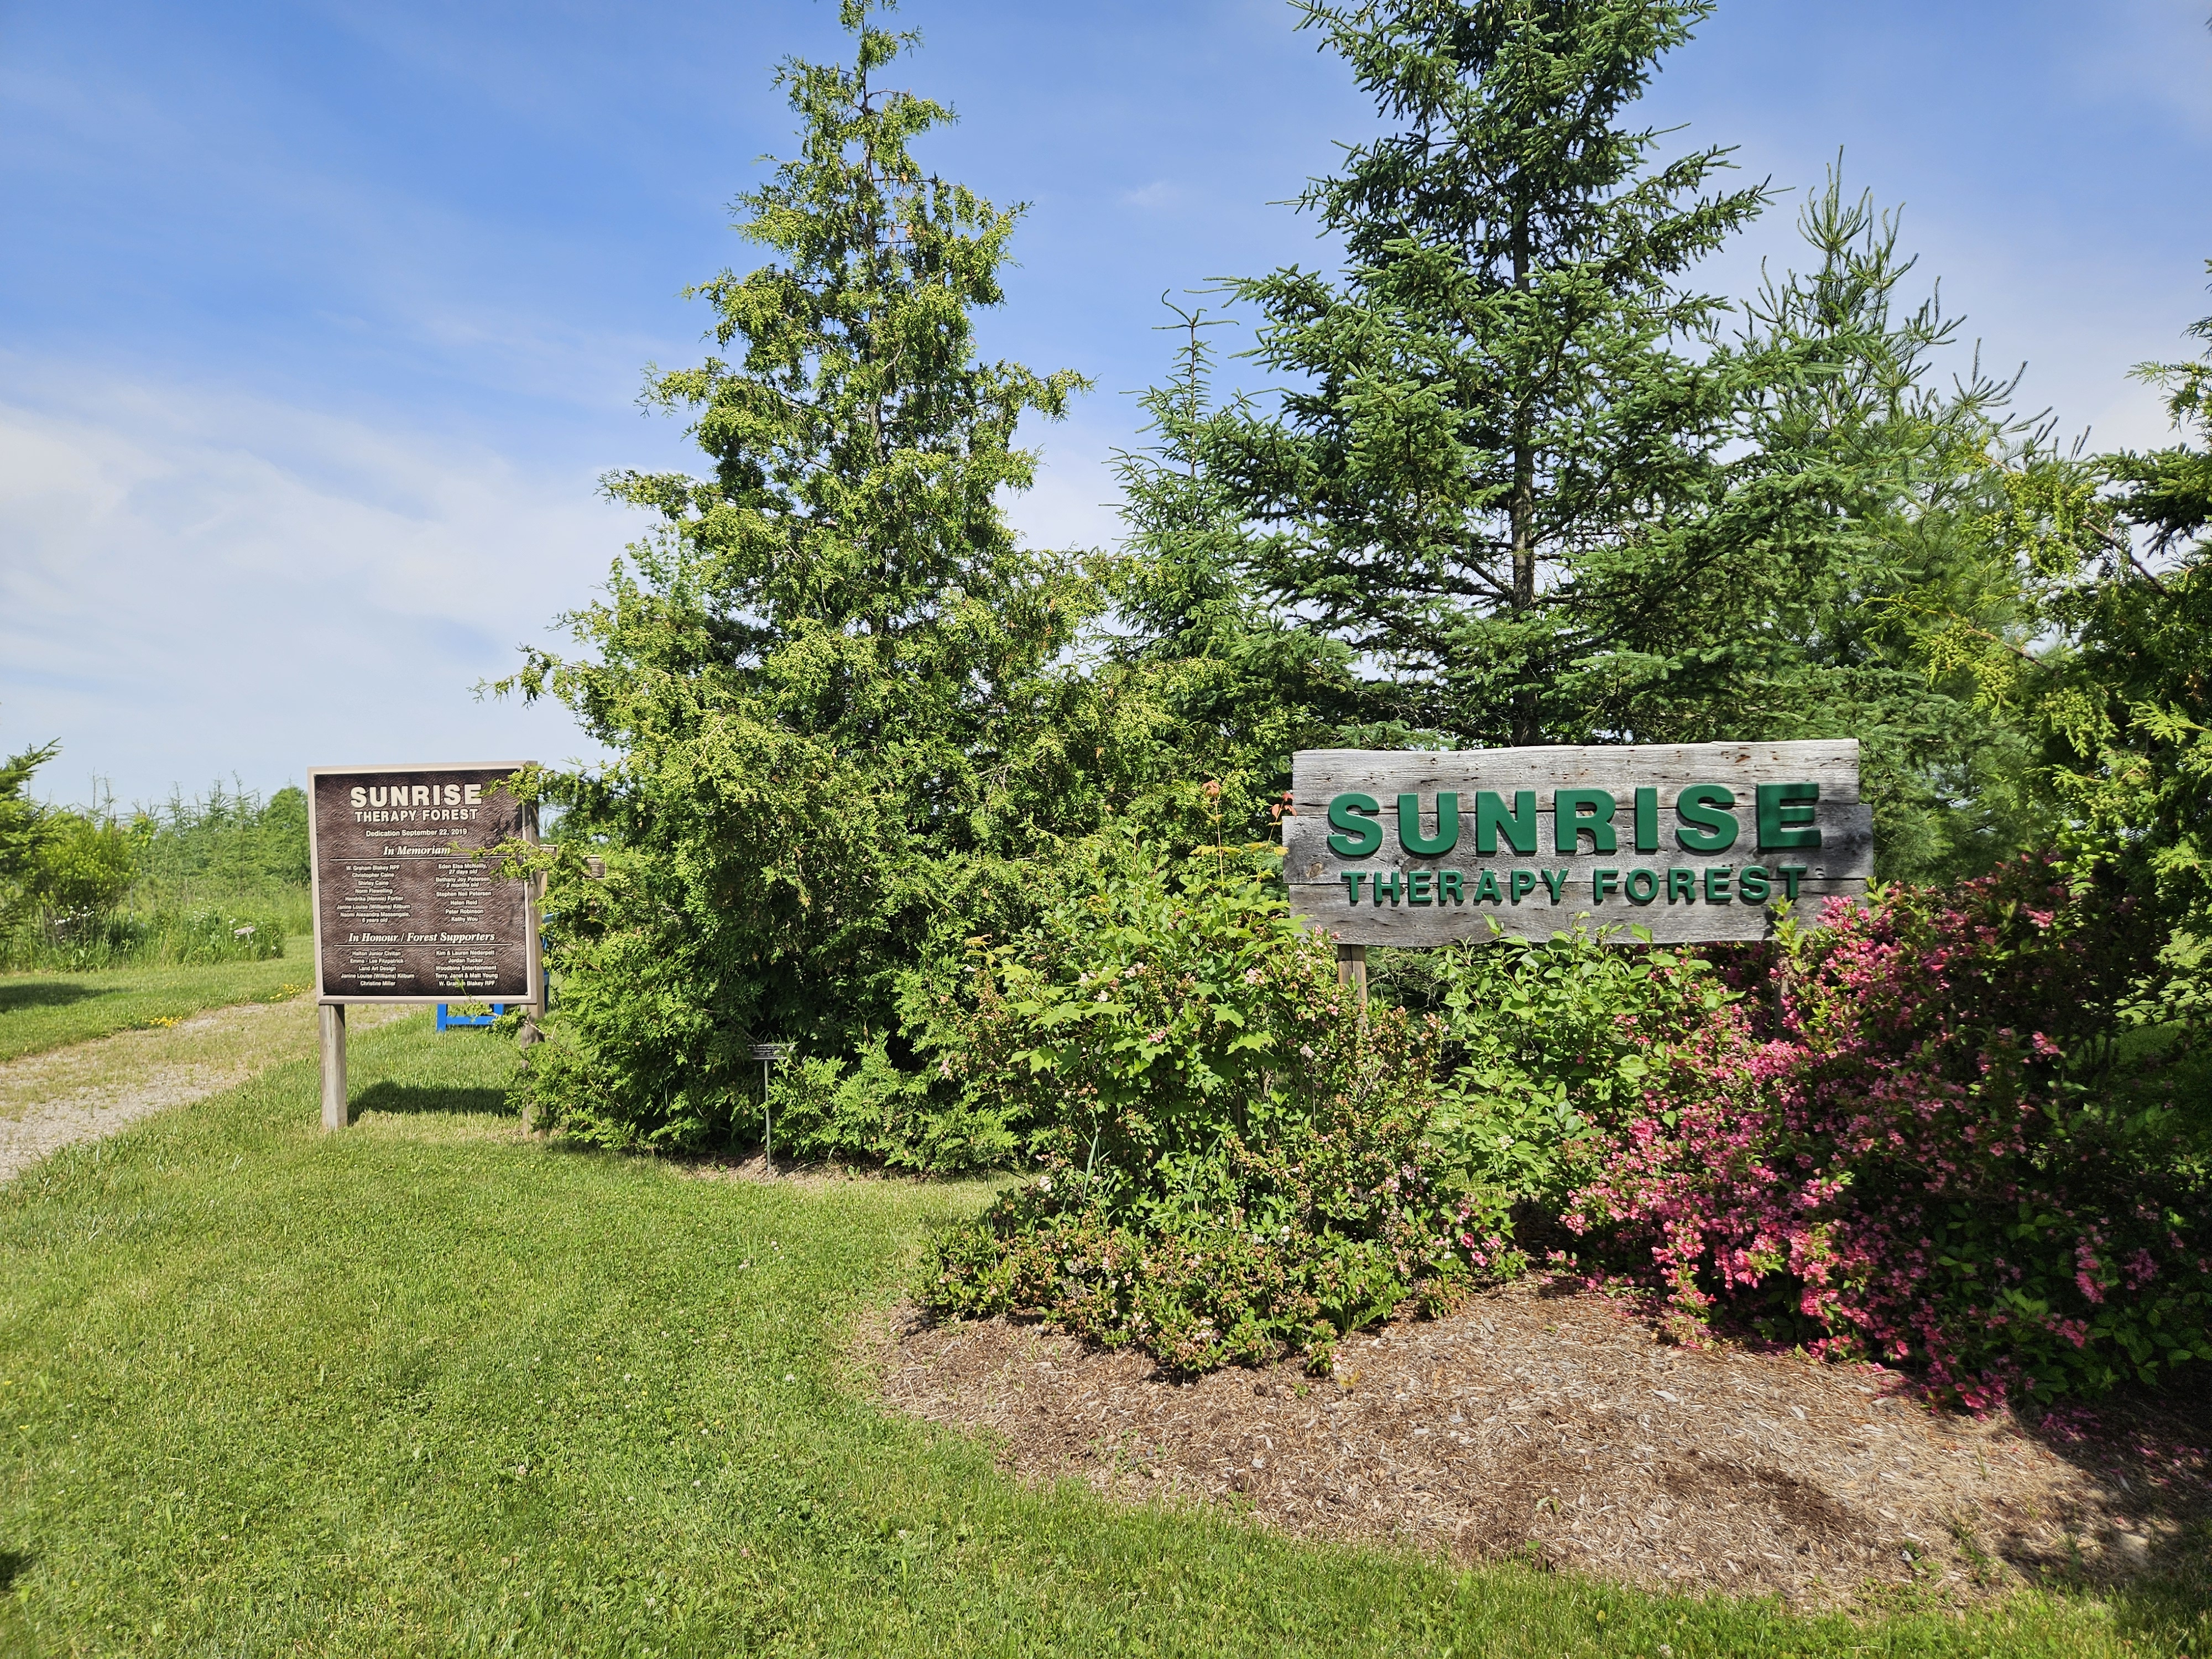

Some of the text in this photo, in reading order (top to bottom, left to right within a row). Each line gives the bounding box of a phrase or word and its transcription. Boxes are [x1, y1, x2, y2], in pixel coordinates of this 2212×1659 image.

[350, 784, 482, 808] SUNRISE
[354, 809, 478, 822] THERAPY FOREST
[1328, 782, 1822, 855] SUNRISE
[401, 829, 437, 837] September
[383, 845, 451, 855] In Memoriam
[1341, 865, 1808, 902] THERAPY FOREST
[348, 932, 495, 943] In Honour / Forest Supporters
